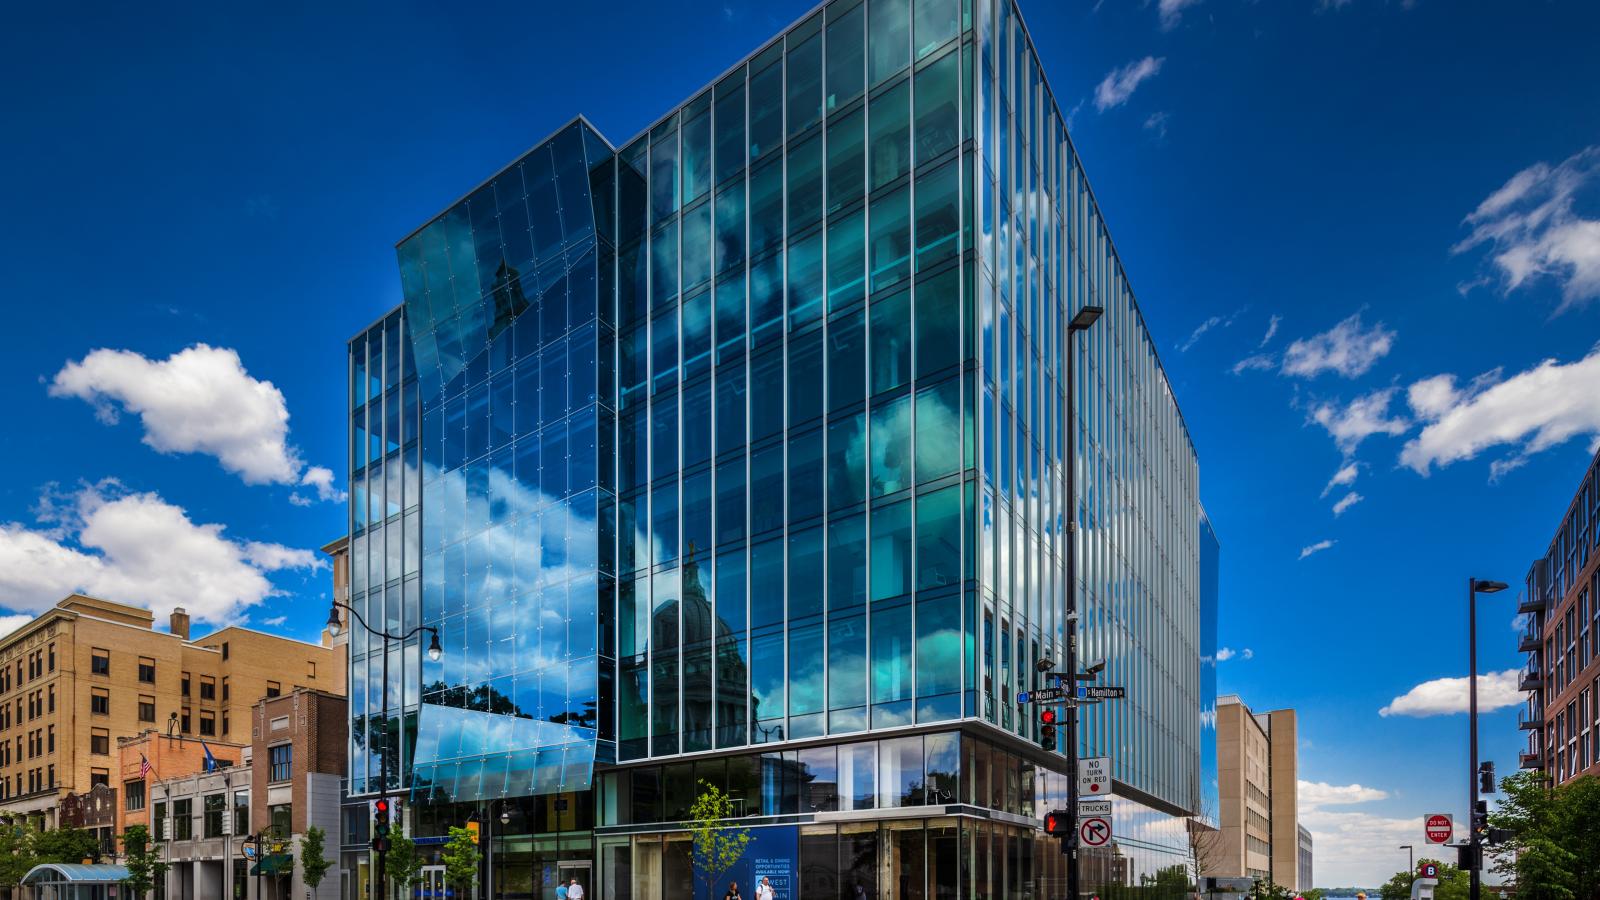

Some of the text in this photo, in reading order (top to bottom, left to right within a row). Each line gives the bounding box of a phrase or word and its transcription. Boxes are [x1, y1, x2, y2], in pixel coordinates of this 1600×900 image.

[1035, 690, 1053, 700] Main
[1092, 688, 1118, 696] Hamilton
[1428, 867, 1434, 876] B
